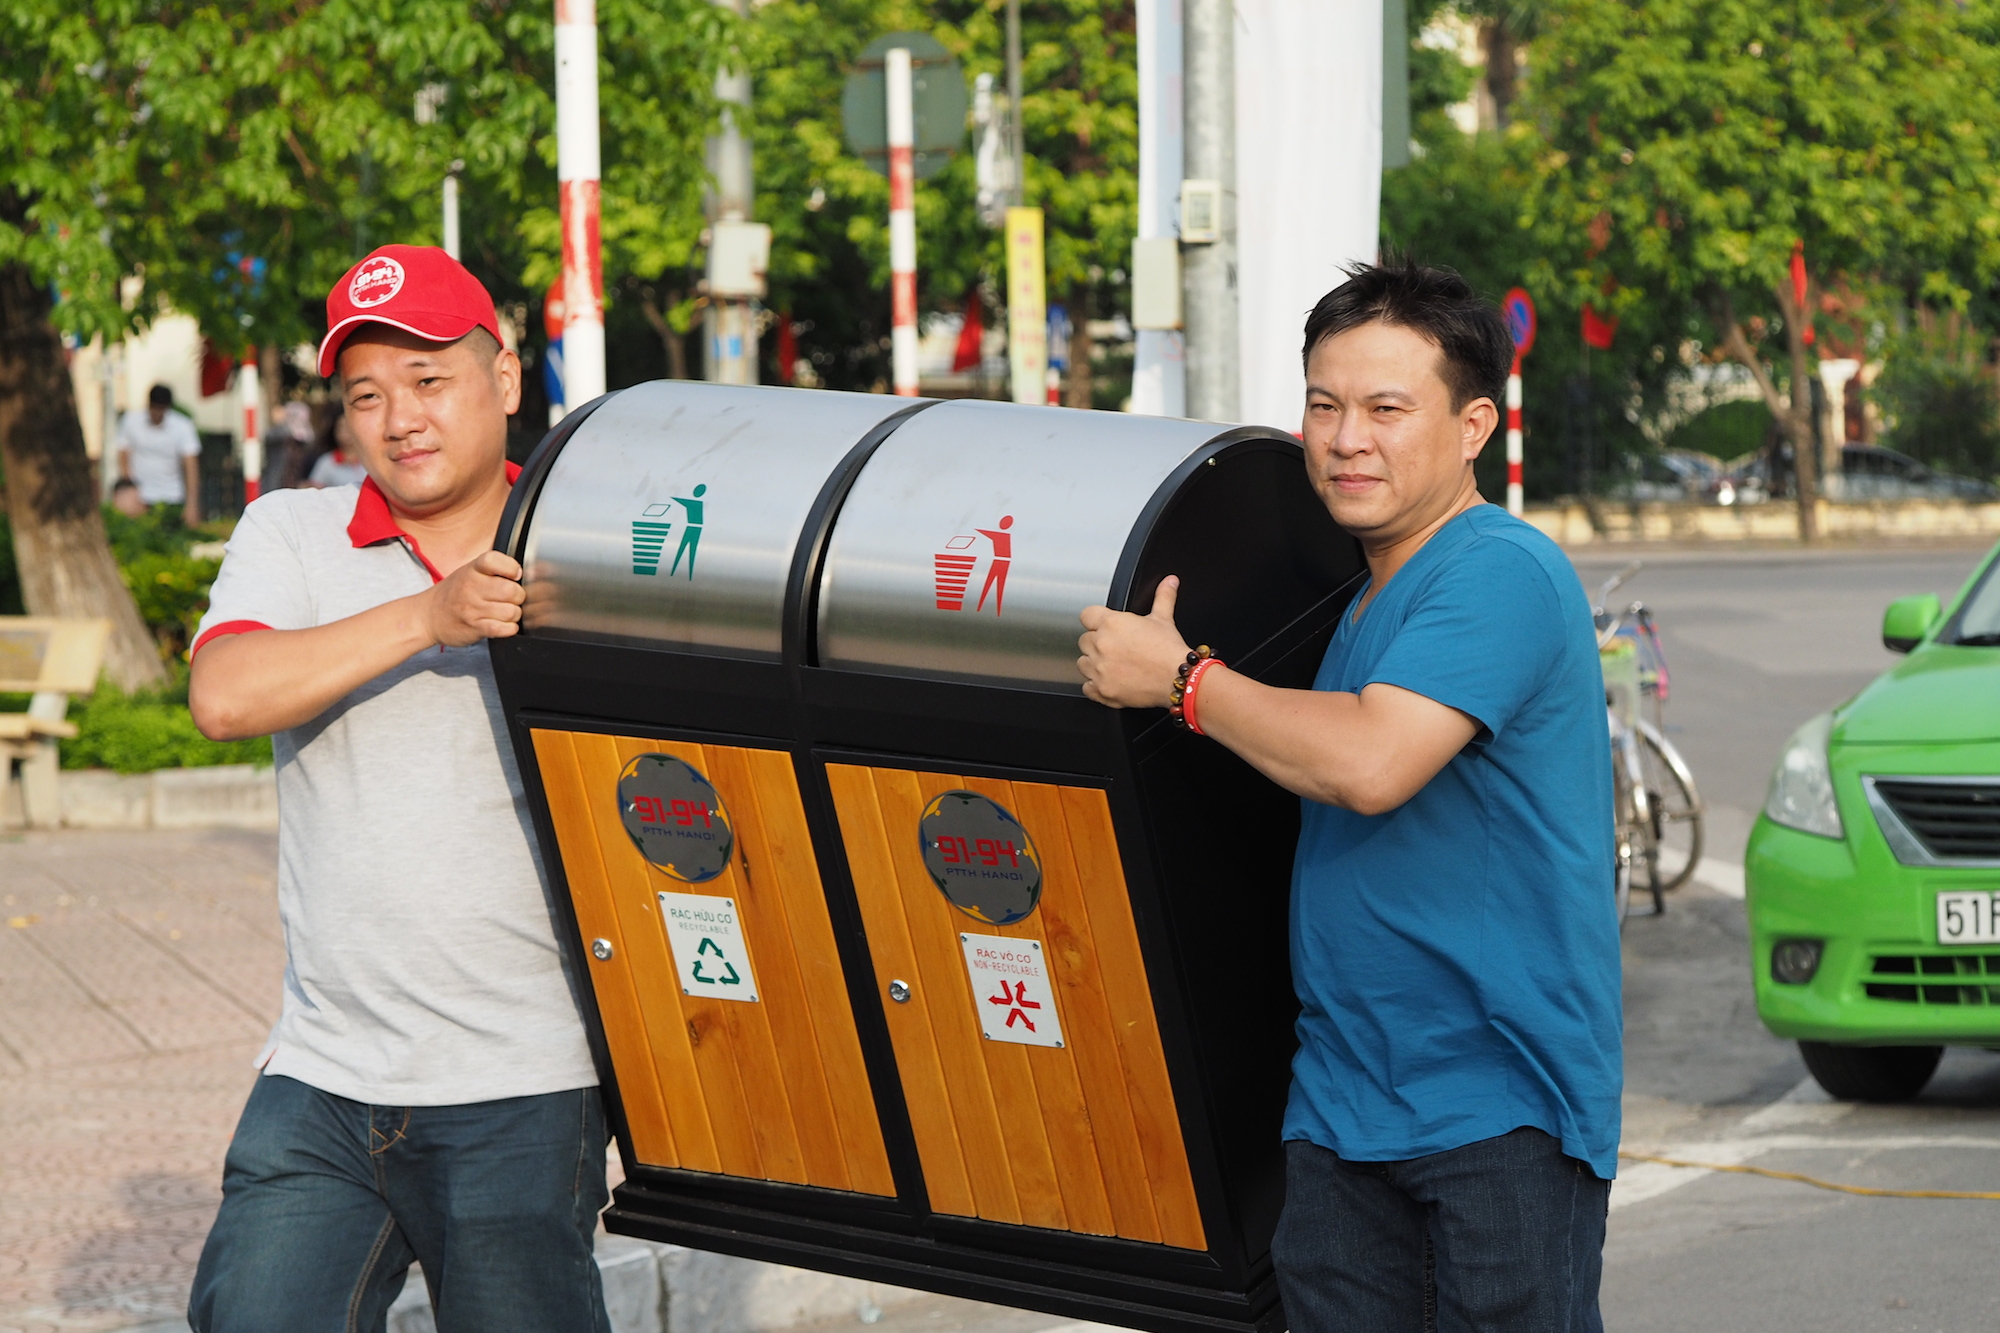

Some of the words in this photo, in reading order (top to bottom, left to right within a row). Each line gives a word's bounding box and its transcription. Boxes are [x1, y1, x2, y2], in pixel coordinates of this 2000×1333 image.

[634, 796, 712, 828] 91-94
[643, 826, 672, 837] PTTH
[677, 830, 716, 841] HANOI
[937, 836, 1019, 868] 91-94
[946, 868, 977, 877] PTTH
[982, 870, 1024, 881] HANOI
[679, 922, 730, 935] RECYCLABLE
[973, 959, 1040, 977] NON-RECYCLABLE
